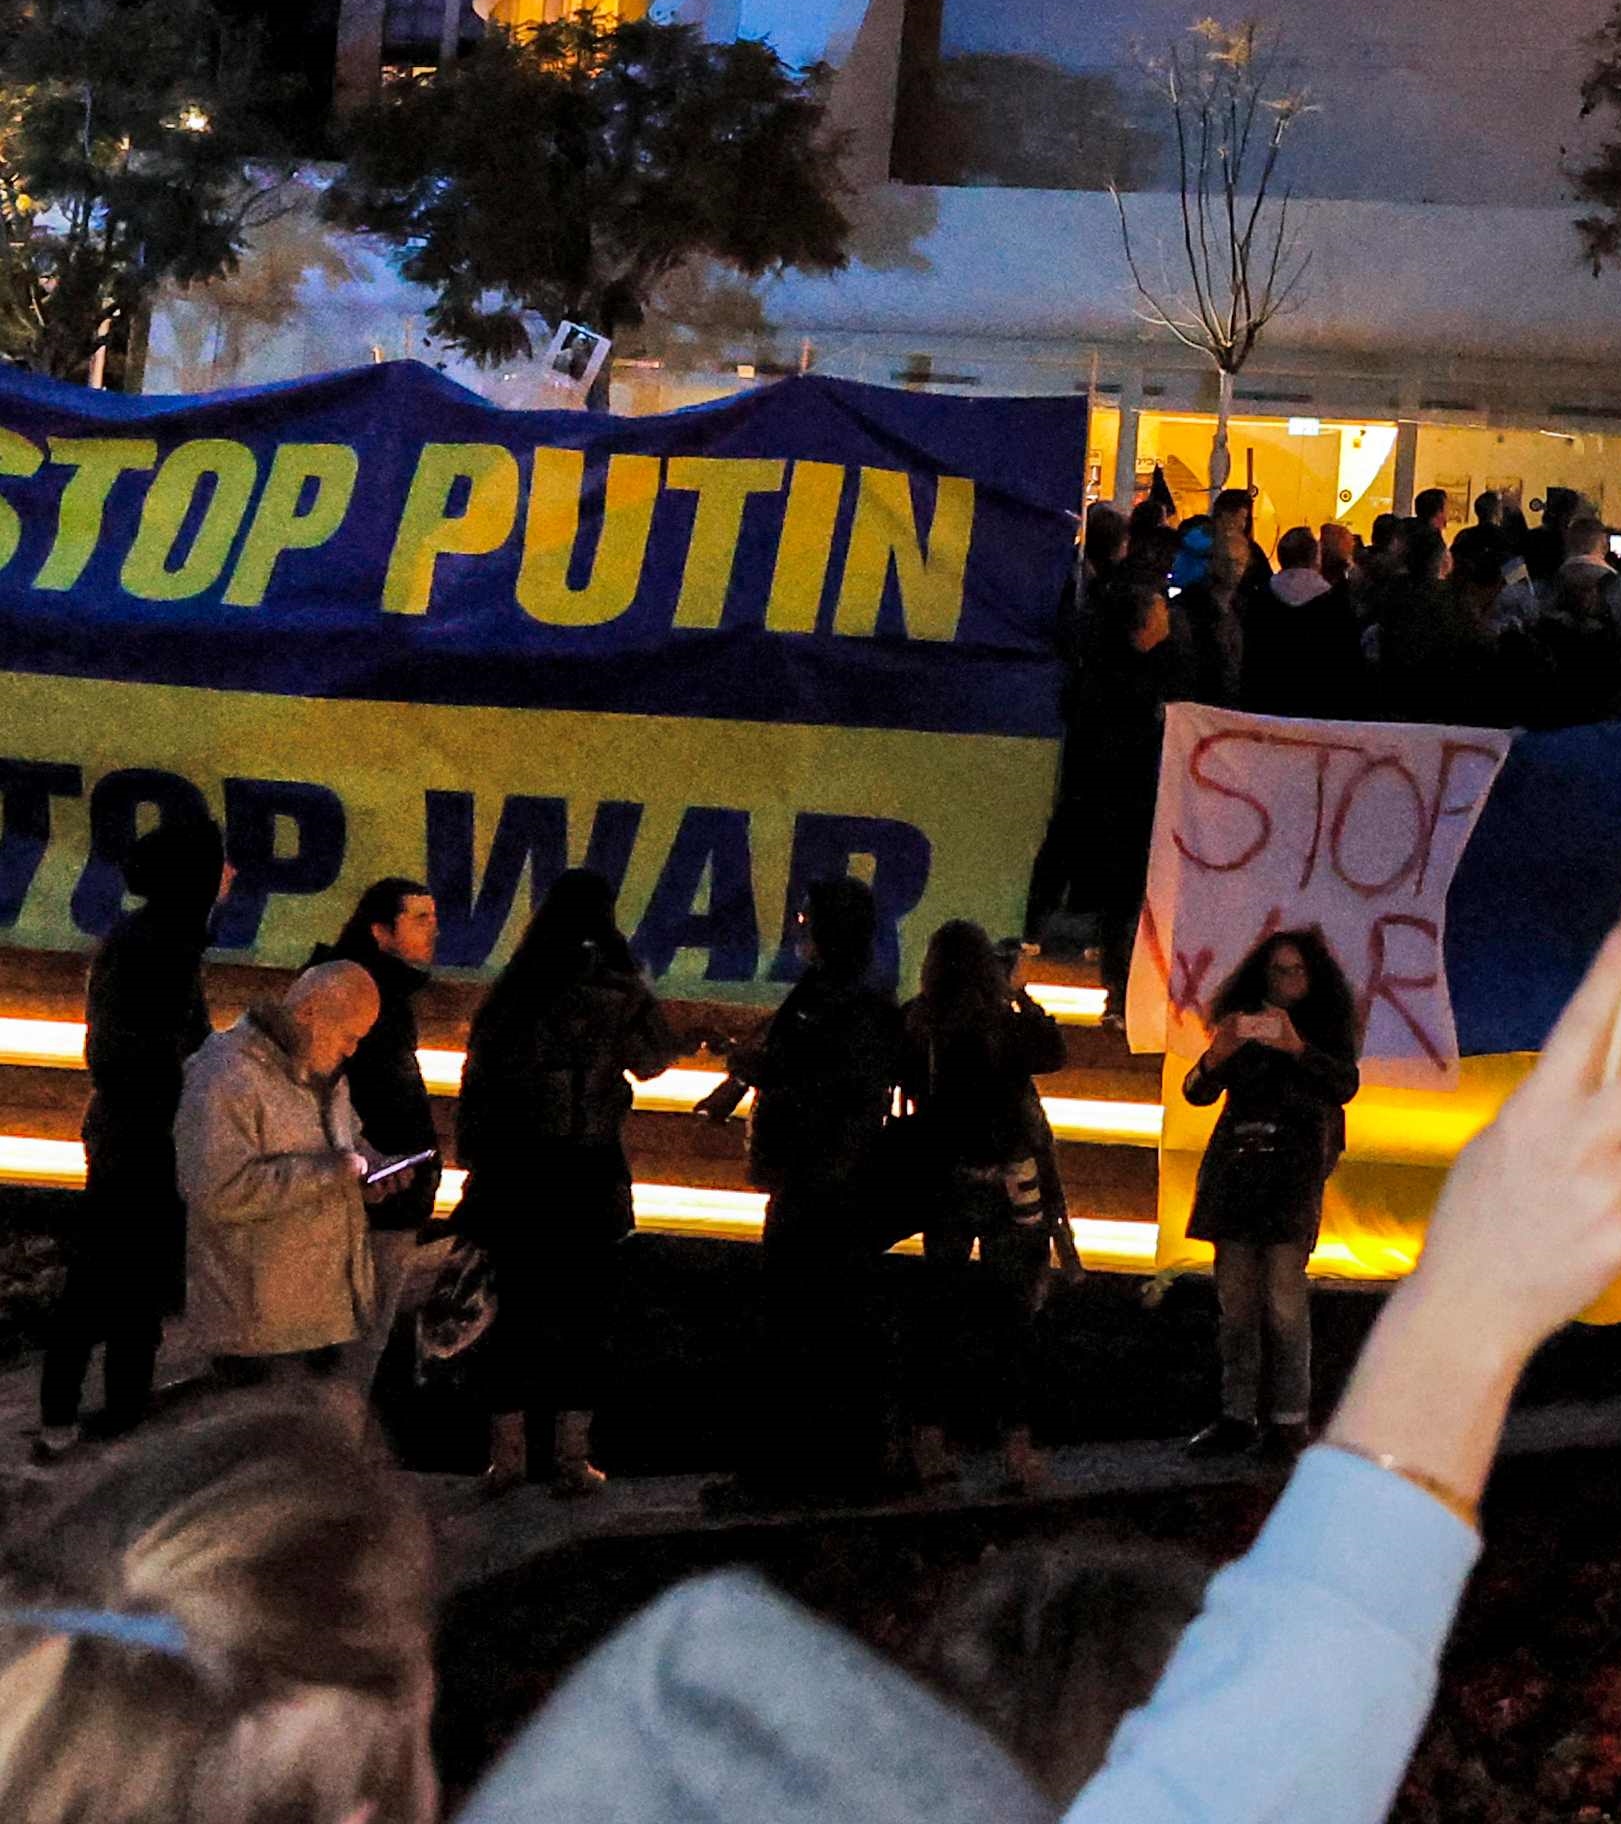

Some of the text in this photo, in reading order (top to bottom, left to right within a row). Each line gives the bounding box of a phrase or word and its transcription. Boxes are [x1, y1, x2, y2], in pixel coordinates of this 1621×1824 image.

[381, 440, 976, 643] PUTIN
[0, 757, 934, 1002] TOP WAR
[1172, 727, 1500, 895] STOP
[1141, 905, 1449, 1072] WR
